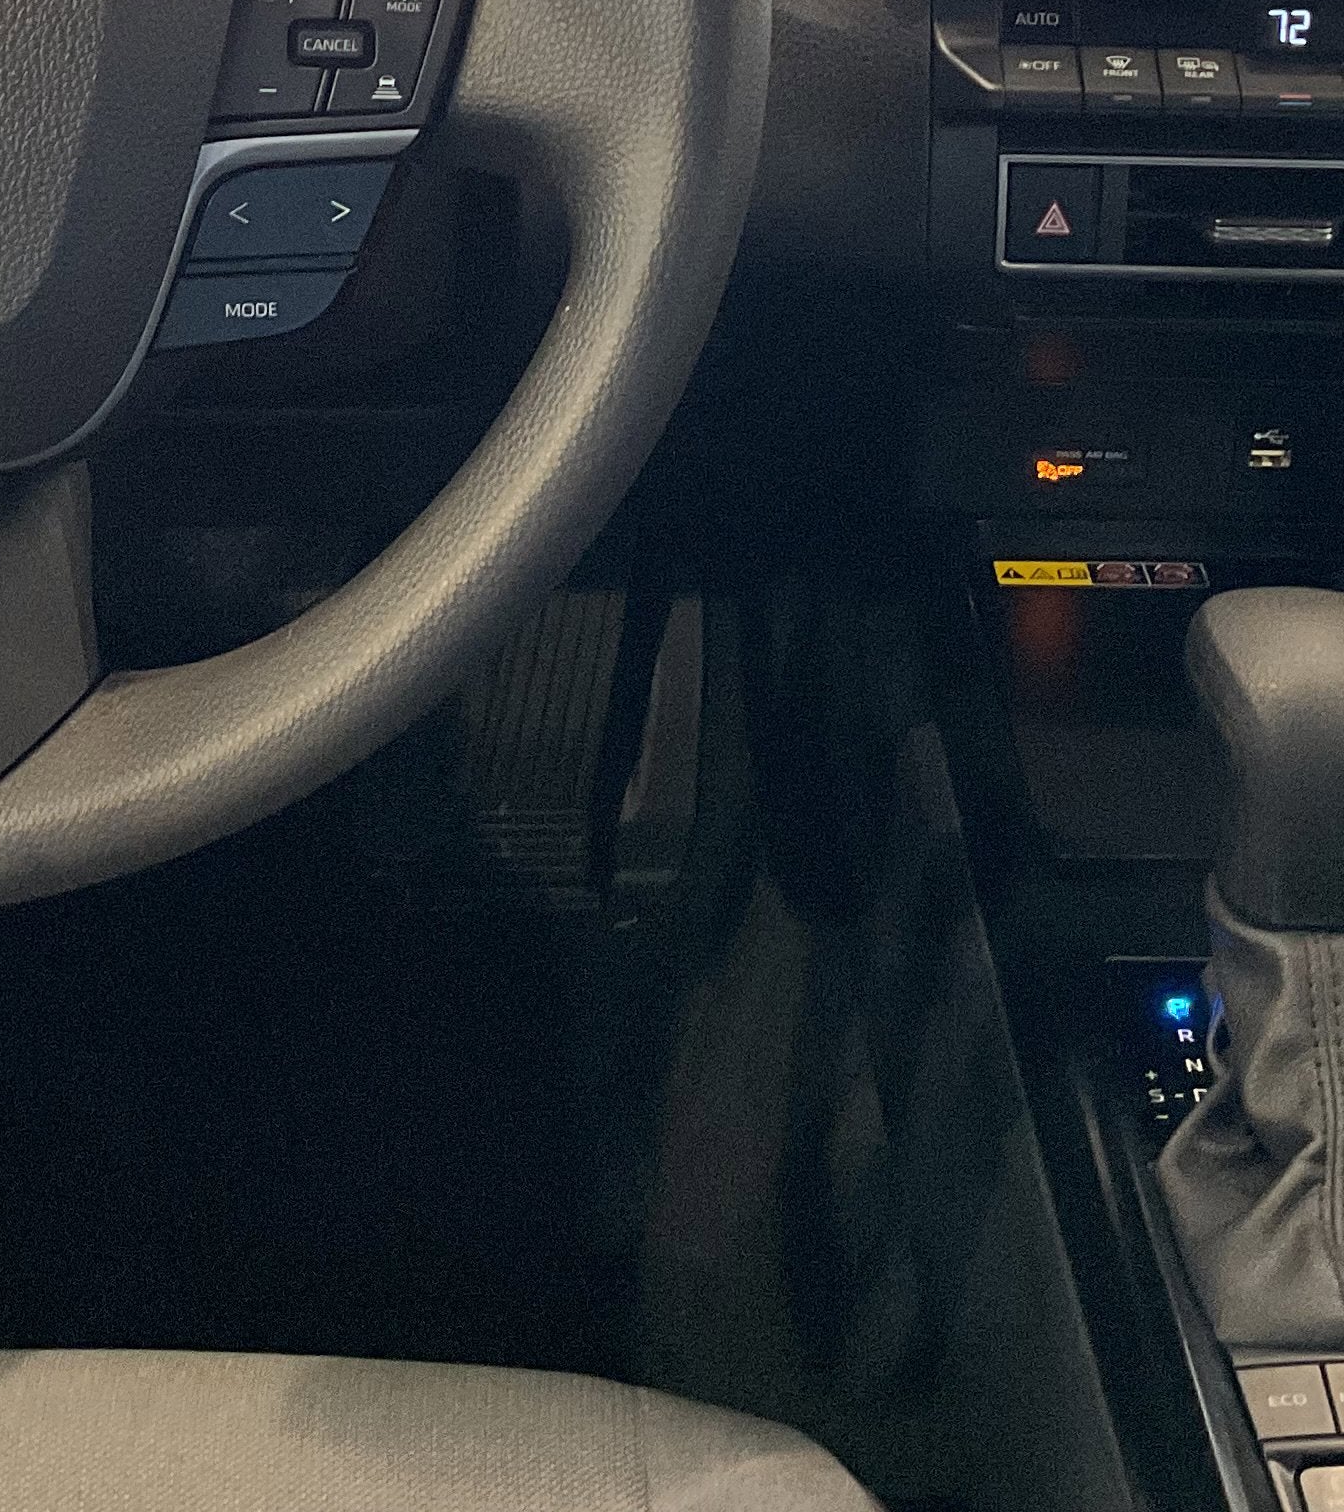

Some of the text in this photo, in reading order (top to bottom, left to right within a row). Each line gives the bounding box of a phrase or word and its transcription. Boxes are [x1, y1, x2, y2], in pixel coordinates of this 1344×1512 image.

[386, 1, 423, 13] MODE
[1015, 12, 1060, 26] AUTO
[1268, 9, 1311, 46] 72
[302, 38, 359, 53] CANCEL
[1103, 69, 1138, 78] FRONT
[225, 302, 278, 318] MODE
[1177, 1028, 1195, 1043] R
[1185, 1058, 1204, 1073] N
[1148, 1088, 1165, 1103] S
[1268, 1393, 1307, 1407] ECO
